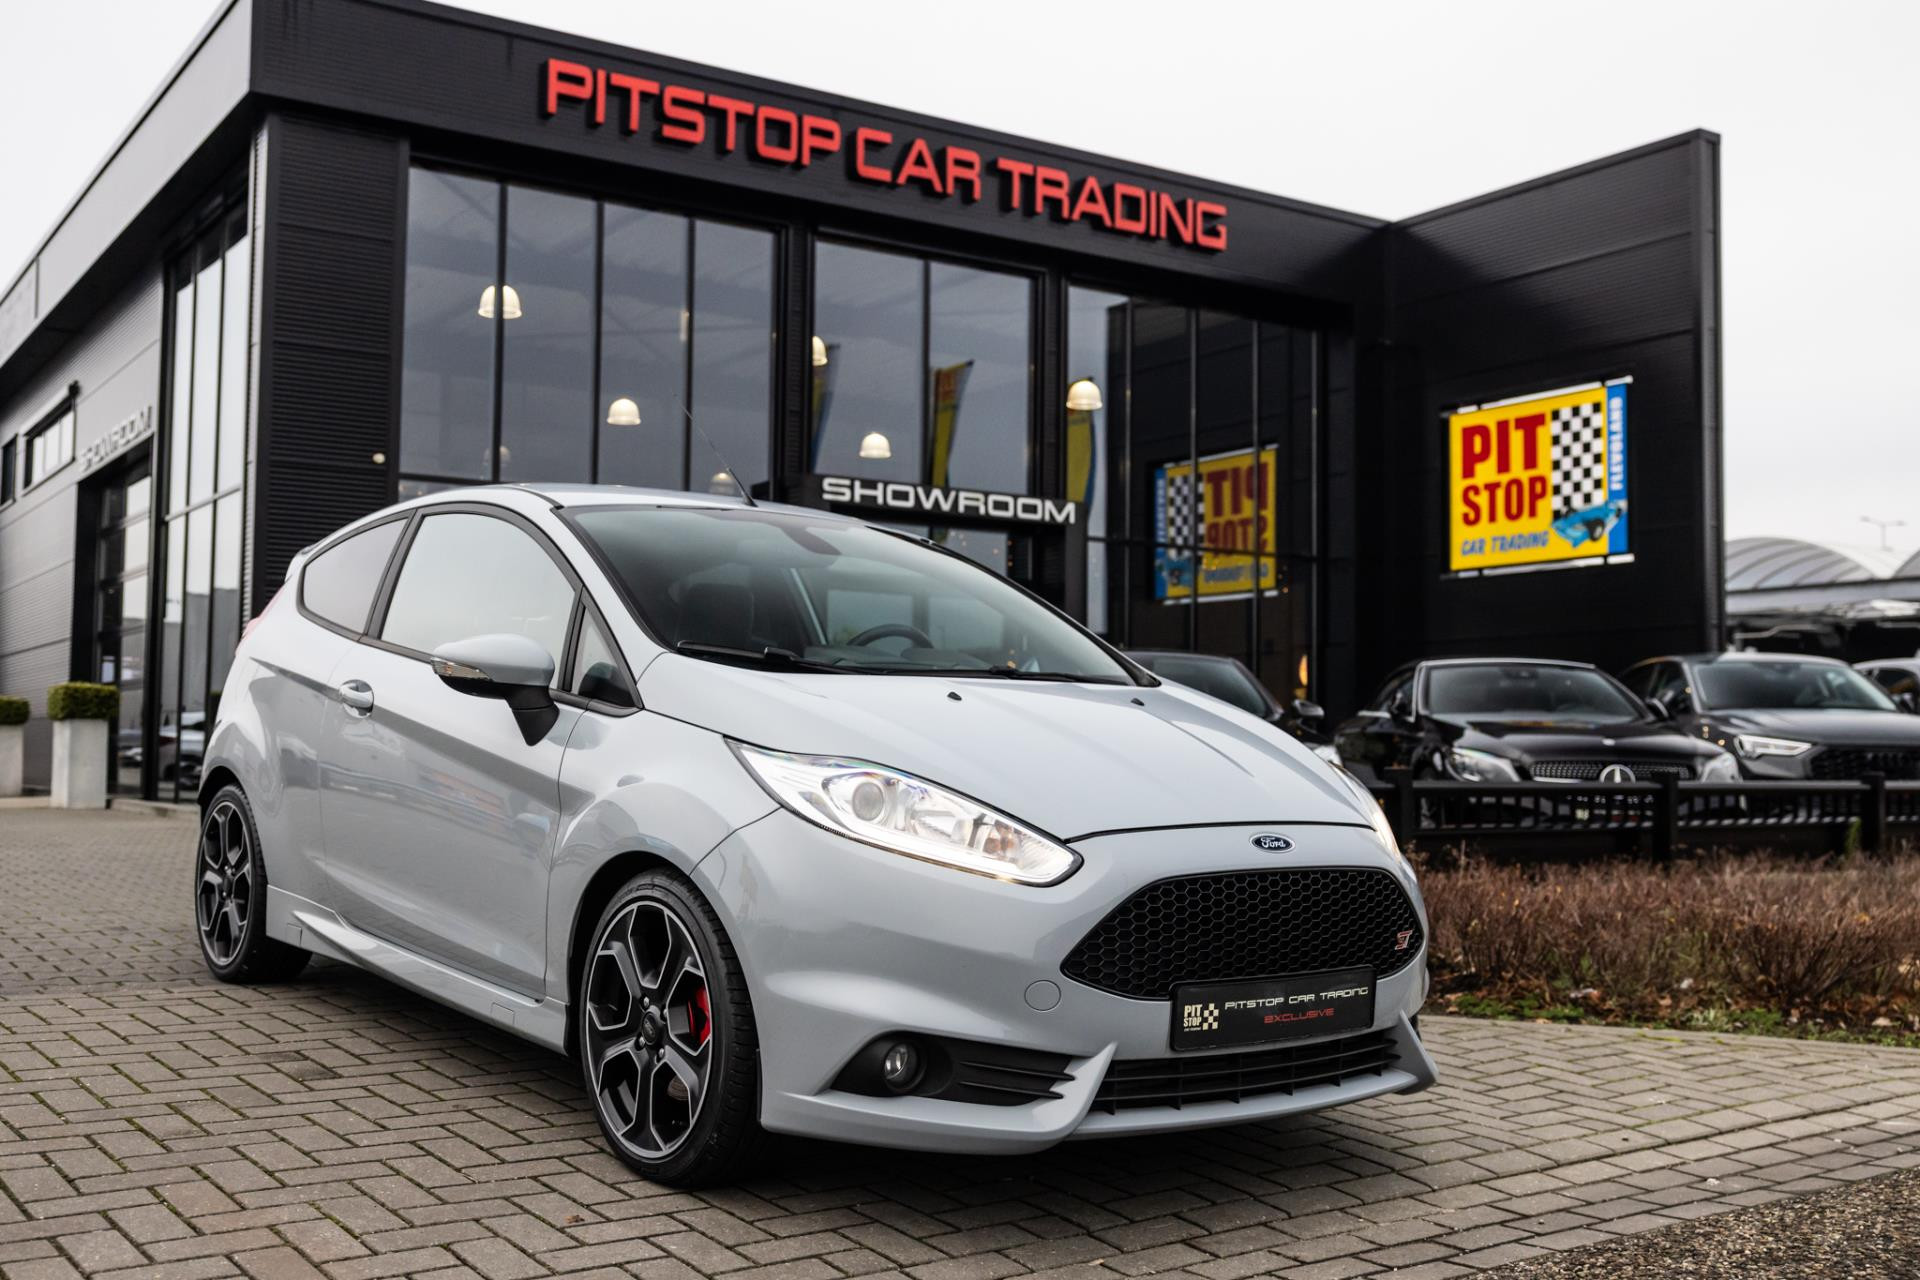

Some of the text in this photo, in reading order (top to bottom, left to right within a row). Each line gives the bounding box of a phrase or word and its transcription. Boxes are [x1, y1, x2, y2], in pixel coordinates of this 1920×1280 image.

[546, 58, 1228, 251] PITSTOP CAR TRADING
[1461, 413, 1546, 480] PIT
[822, 477, 1076, 524] SHOWROOM
[1461, 475, 1547, 527] STOP
[1461, 530, 1549, 557] CAR TRADING
[1260, 837, 1287, 848] Ford
[1183, 1003, 1203, 1018] PIT
[1224, 986, 1369, 1010] PITSTOP CAR TRADING
[1183, 1017, 1202, 1027] STOP
[1264, 1007, 1335, 1024] EXCLUSIVE
